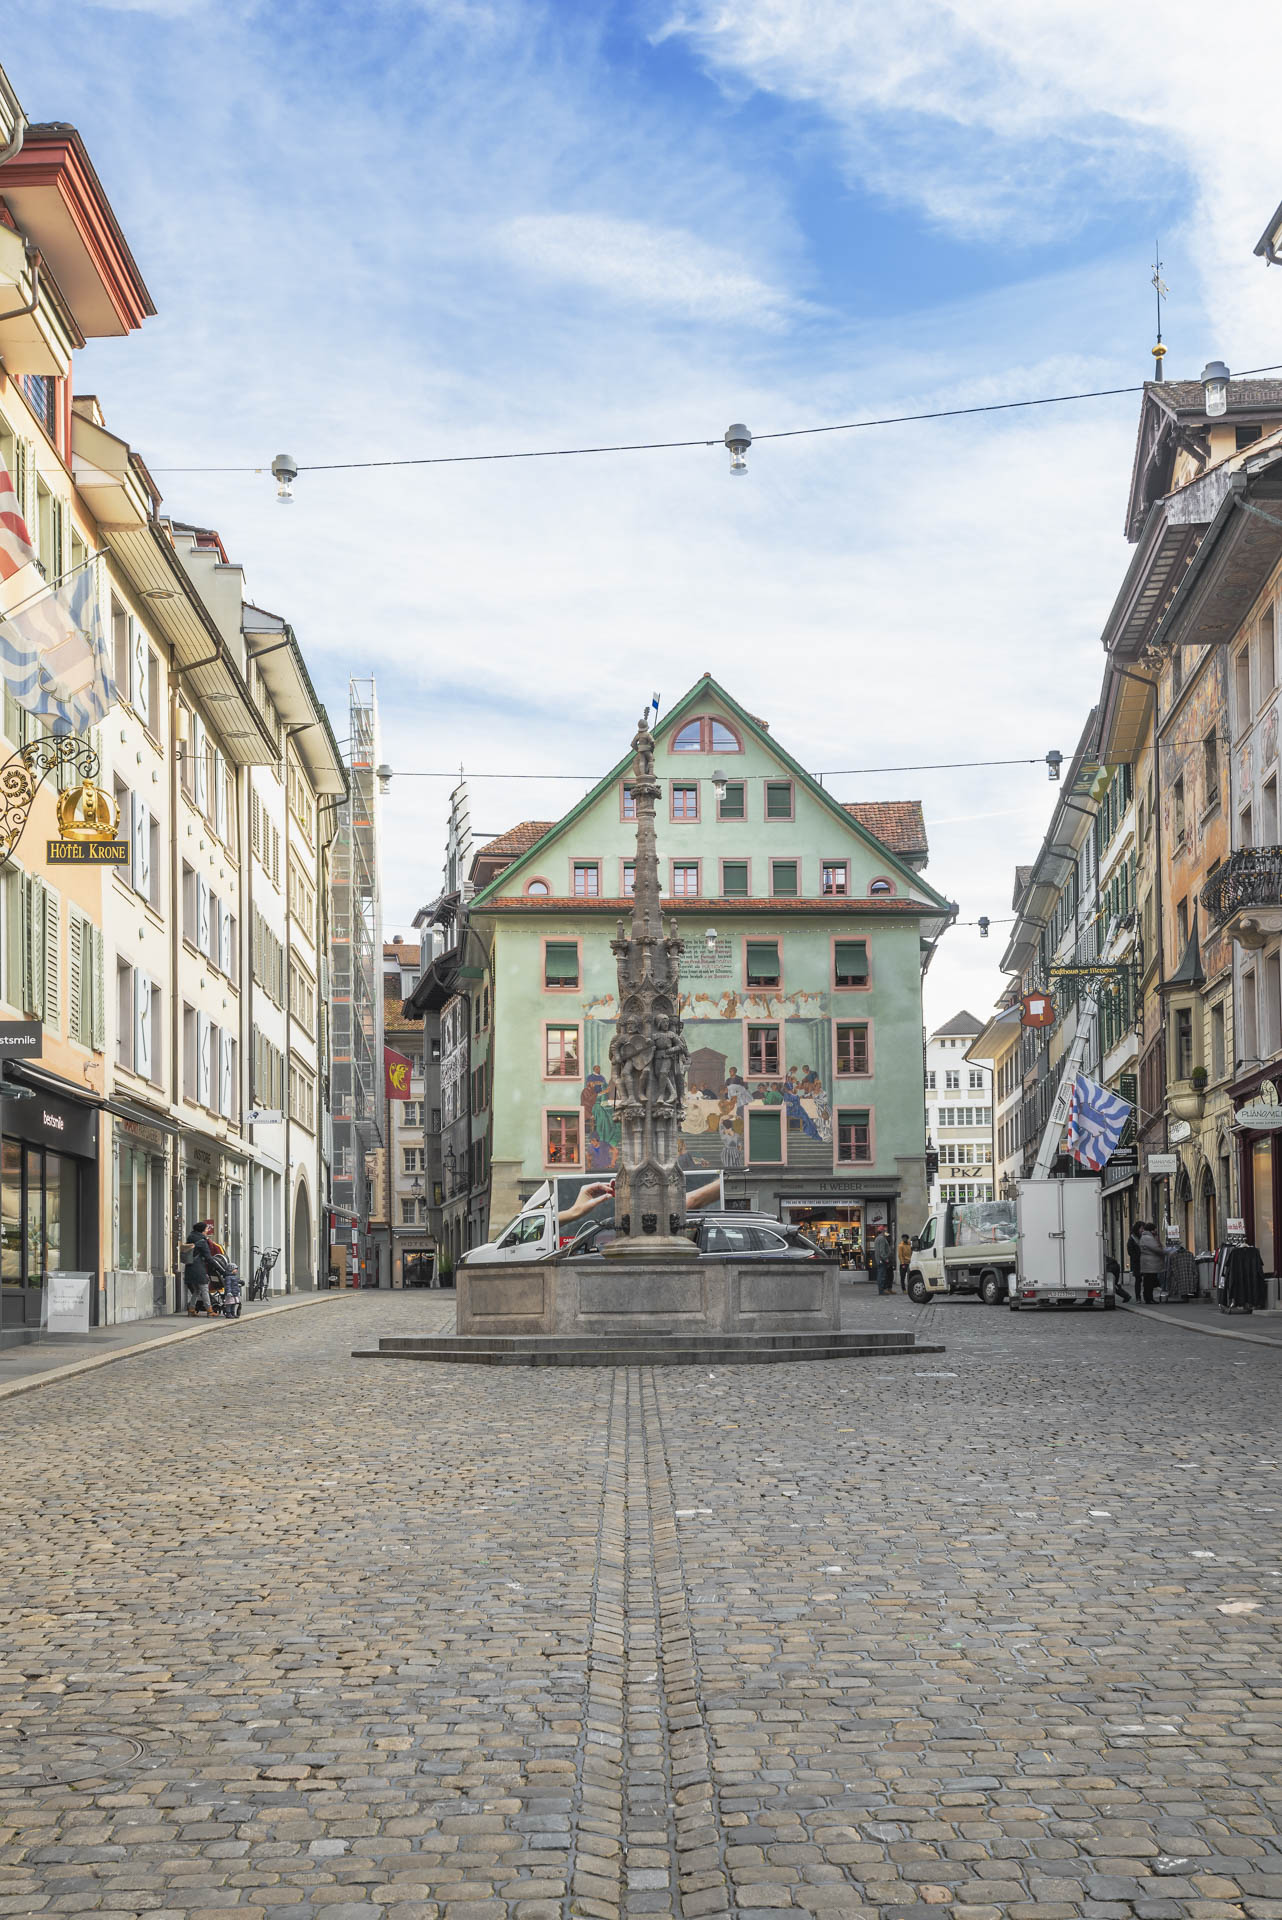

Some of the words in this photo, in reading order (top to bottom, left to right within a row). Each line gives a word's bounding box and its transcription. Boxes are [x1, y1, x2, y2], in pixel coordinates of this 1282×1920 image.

[89, 843, 126, 858] KRONE
[43, 1110, 64, 1130] bestsmile
[950, 1167, 983, 1177] PKZ
